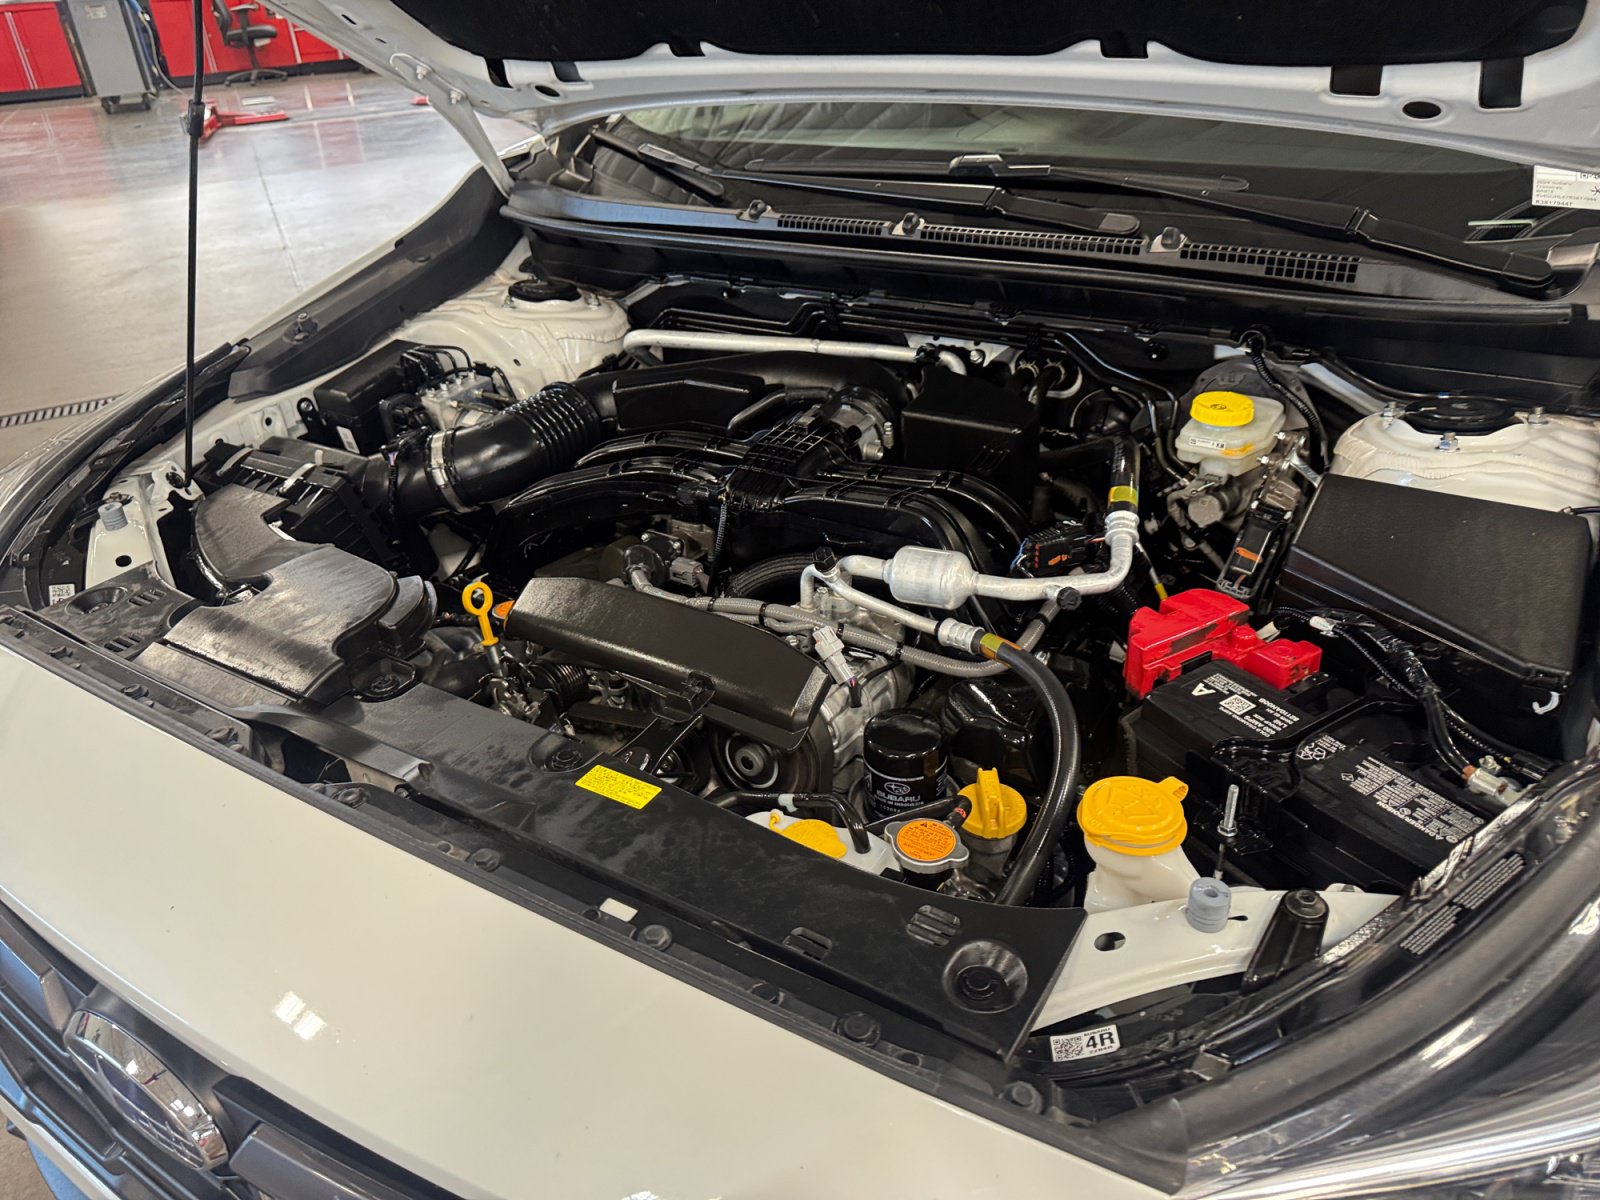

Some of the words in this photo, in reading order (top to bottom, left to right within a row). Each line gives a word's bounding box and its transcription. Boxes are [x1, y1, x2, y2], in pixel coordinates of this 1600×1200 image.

[1243, 715, 1264, 727] AMPS
[876, 789, 921, 802] SUBARU
[1085, 1031, 1116, 1049] 4R
